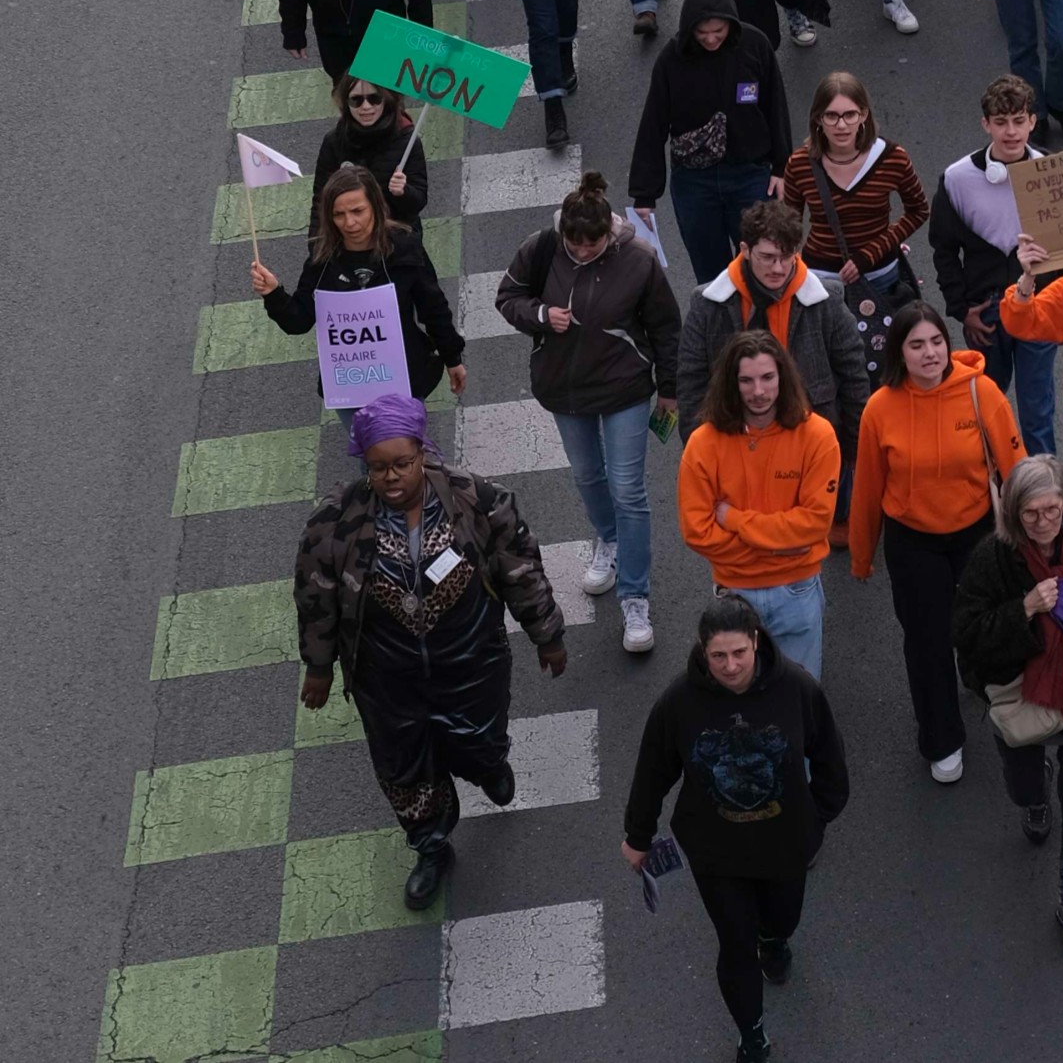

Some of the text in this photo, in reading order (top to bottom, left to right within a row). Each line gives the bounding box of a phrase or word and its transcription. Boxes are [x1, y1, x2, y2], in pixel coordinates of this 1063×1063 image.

[395, 57, 485, 113] NON
[1036, 159, 1048, 172] LE
[1026, 179, 1040, 193] ON
[1037, 207, 1060, 223] PAS
[326, 309, 385, 323] À TRAVAIL
[328, 324, 387, 345] ÉGAL
[330, 351, 376, 363] SALAIRE
[334, 363, 392, 385] ÉGAL
